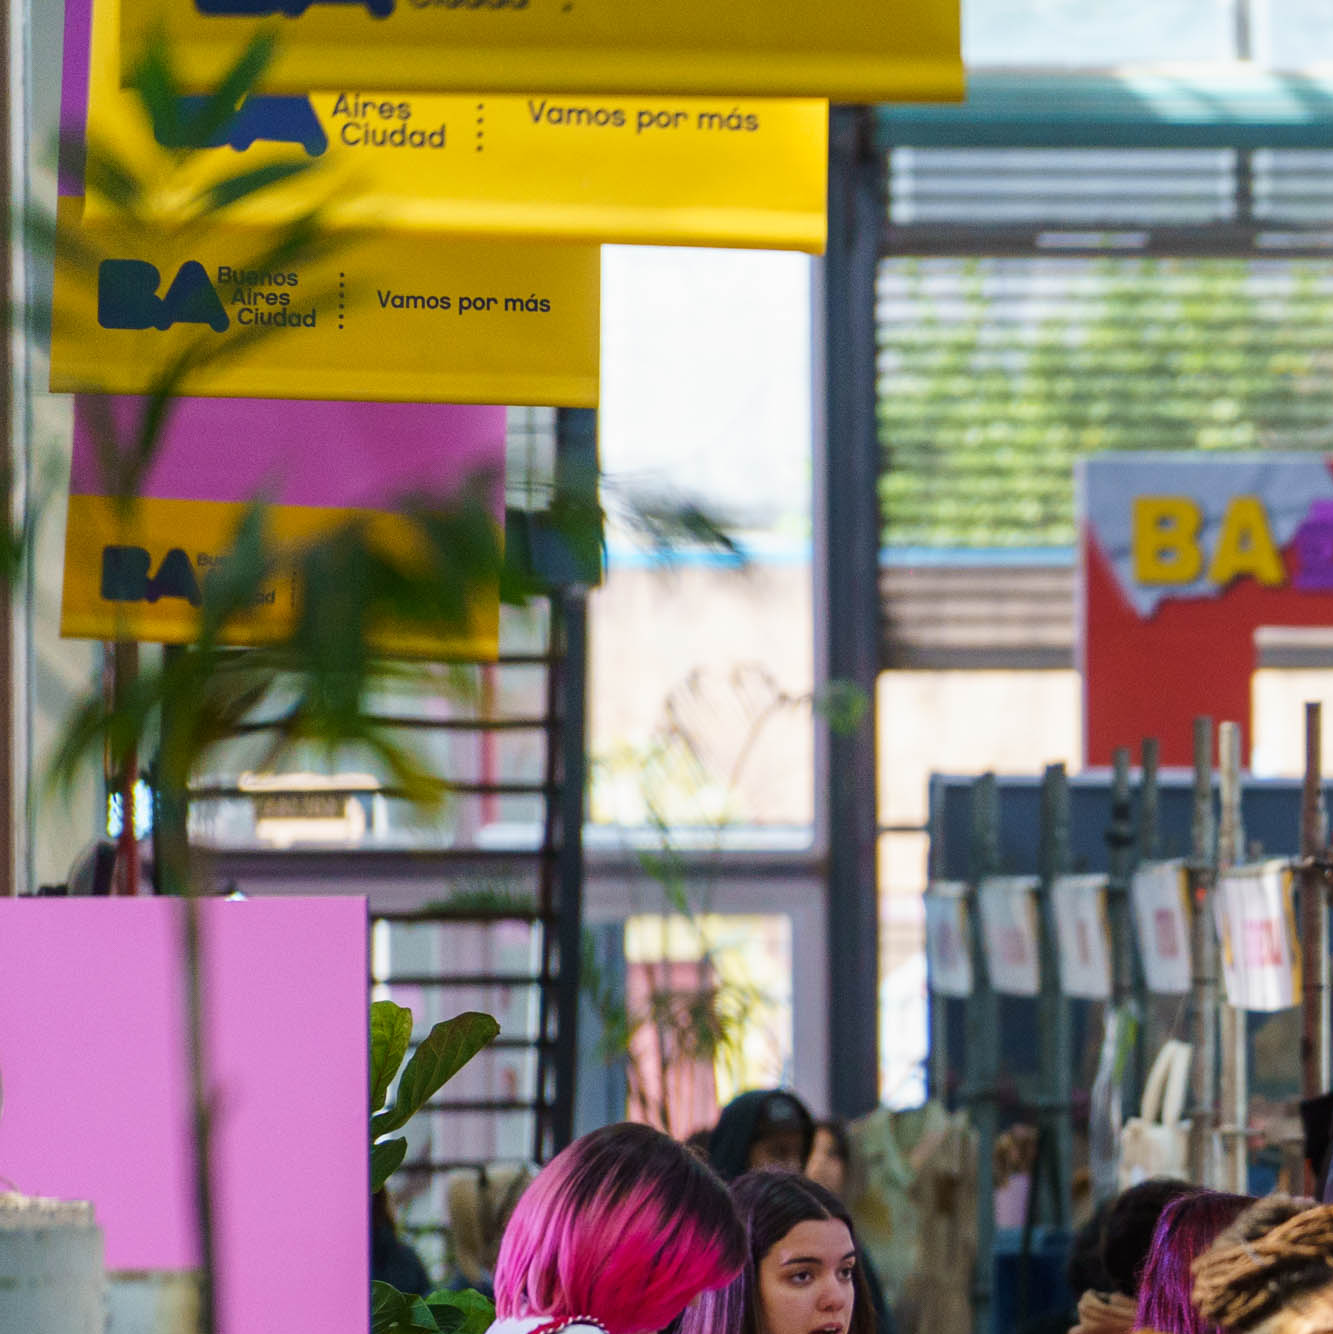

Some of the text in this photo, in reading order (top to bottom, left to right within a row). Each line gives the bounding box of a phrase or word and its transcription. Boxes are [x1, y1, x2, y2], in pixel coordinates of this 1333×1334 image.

[332, 94, 412, 120] Aires
[528, 99, 760, 135] Vamos por más
[341, 122, 447, 149] Ciudad
[217, 266, 299, 287] Buenos
[98, 259, 230, 333] BA
[231, 288, 291, 307] Aires
[377, 290, 551, 316] Vamos por más
[237, 307, 317, 328] Ciudad
[102, 544, 202, 607] BA
